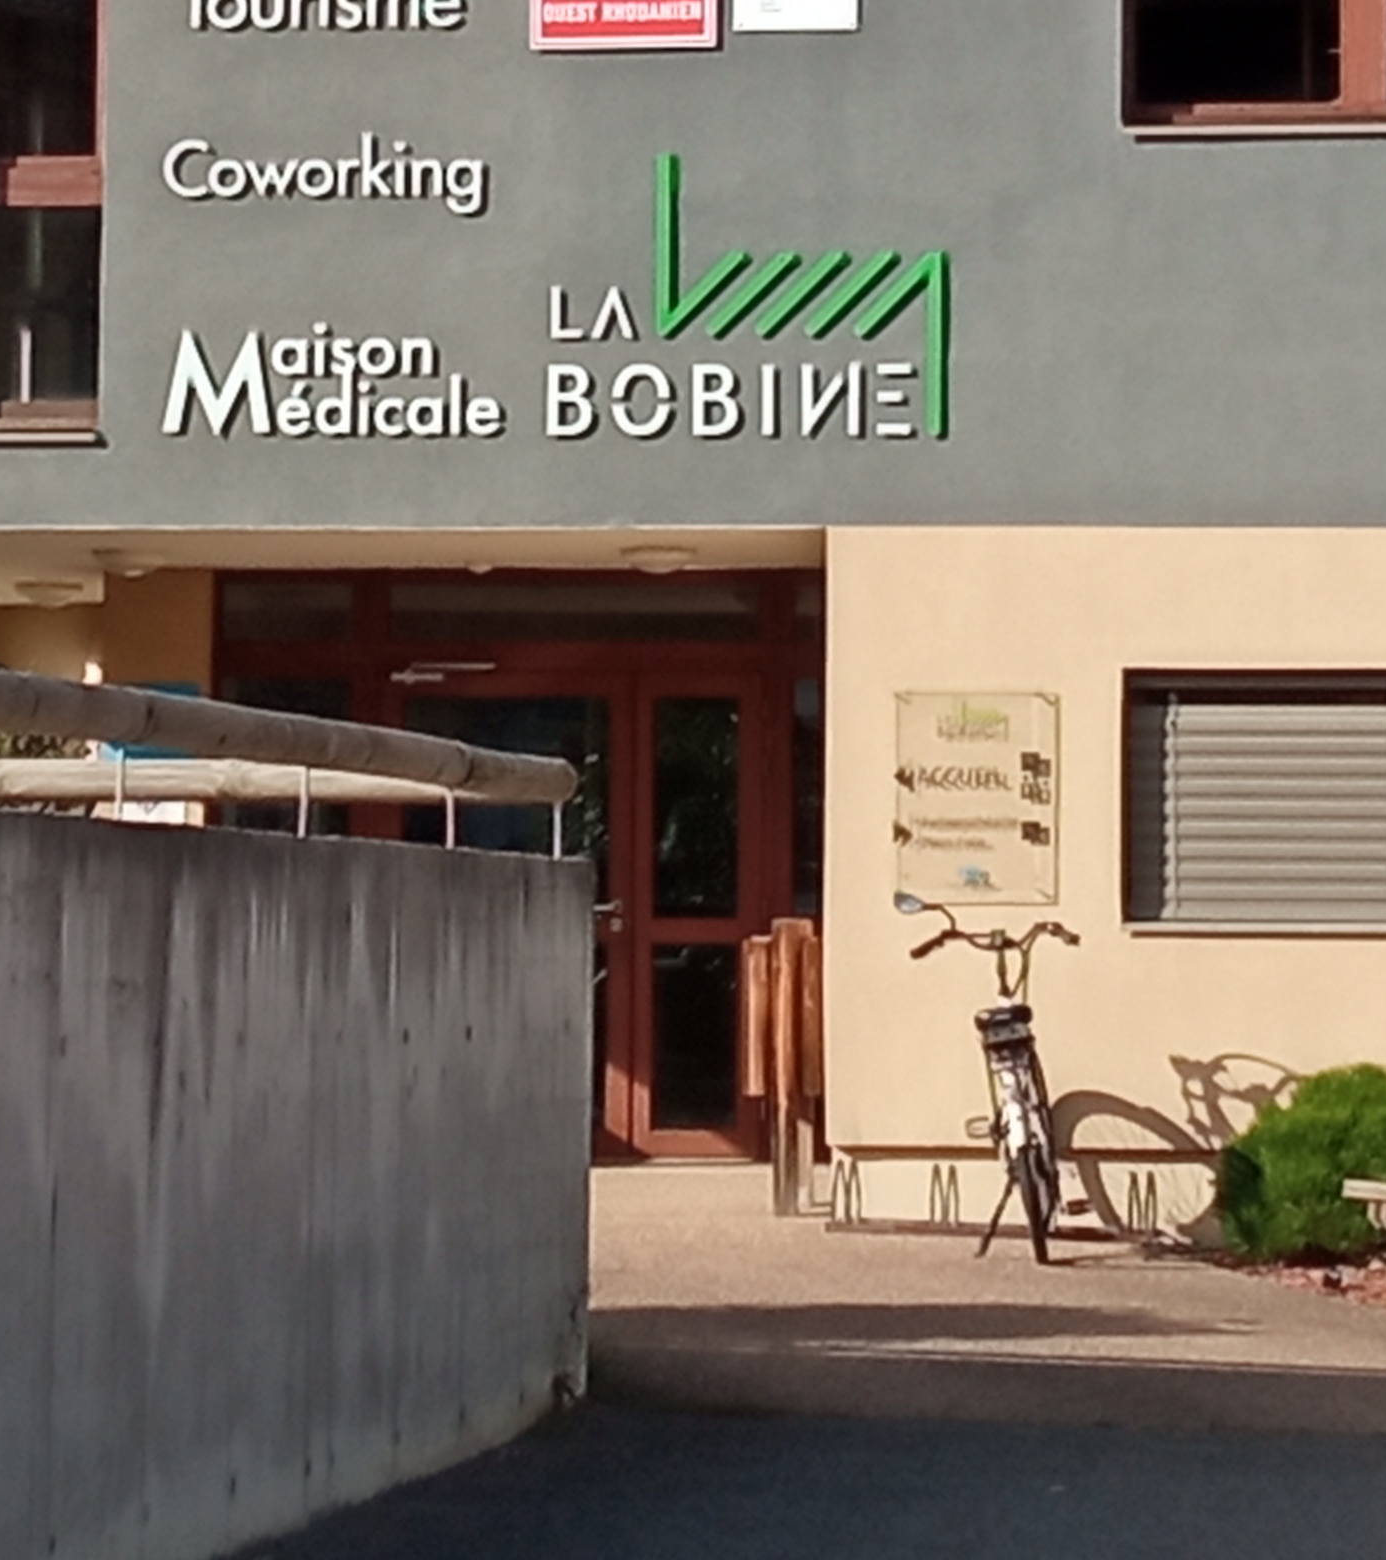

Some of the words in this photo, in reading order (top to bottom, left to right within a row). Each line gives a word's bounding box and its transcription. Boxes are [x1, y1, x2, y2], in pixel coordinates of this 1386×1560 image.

[543, 1, 598, 23] OUEST
[162, 130, 485, 216] Coworking
[549, 284, 636, 342] LA
[162, 328, 503, 437] Médicale
[545, 359, 916, 438] BOBINE
